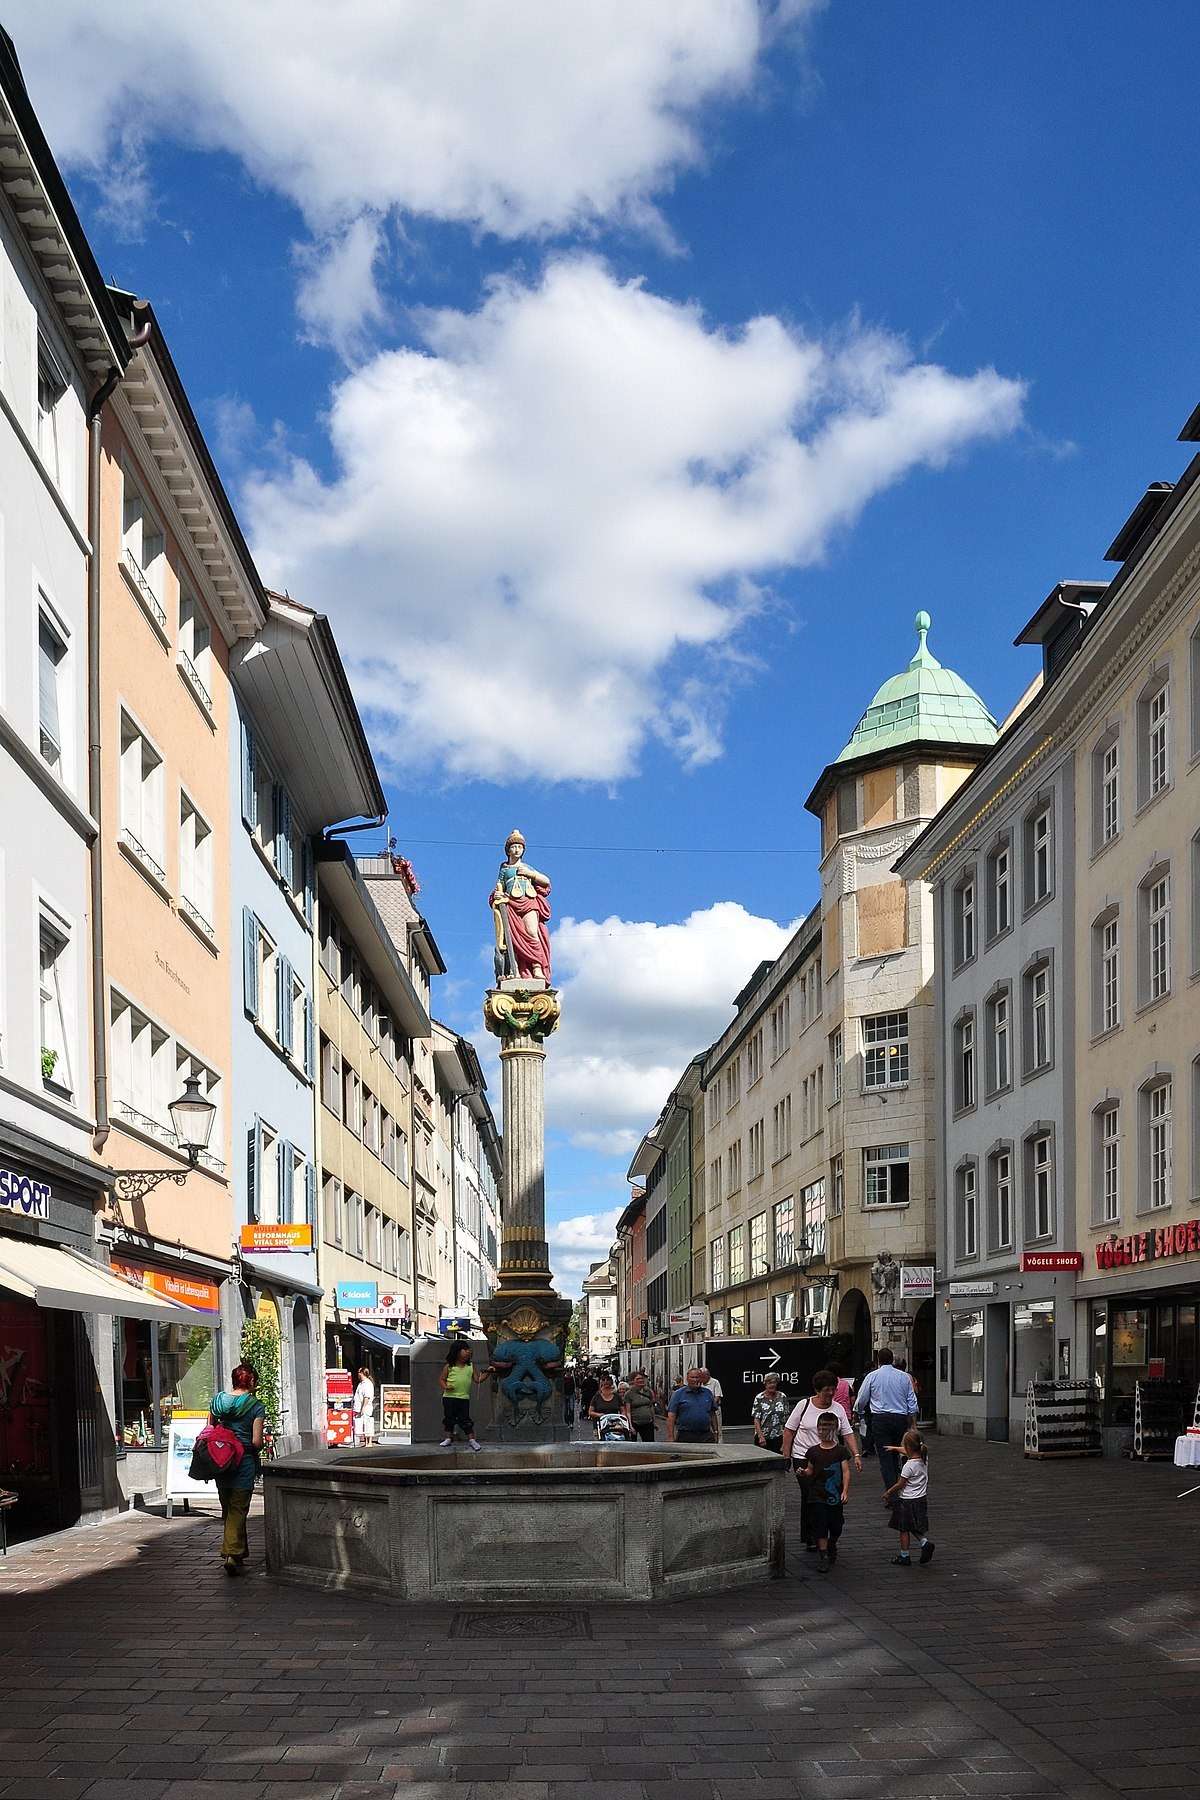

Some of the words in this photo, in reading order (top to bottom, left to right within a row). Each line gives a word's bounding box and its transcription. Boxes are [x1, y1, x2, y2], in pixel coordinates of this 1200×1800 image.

[0, 1169, 51, 1219] SPORT
[1096, 1232, 1146, 1269] VÖGELE
[1027, 1257, 1053, 1265] VÖGELE
[743, 1371, 799, 1384] Einng
[384, 1412, 411, 1428] SALE
